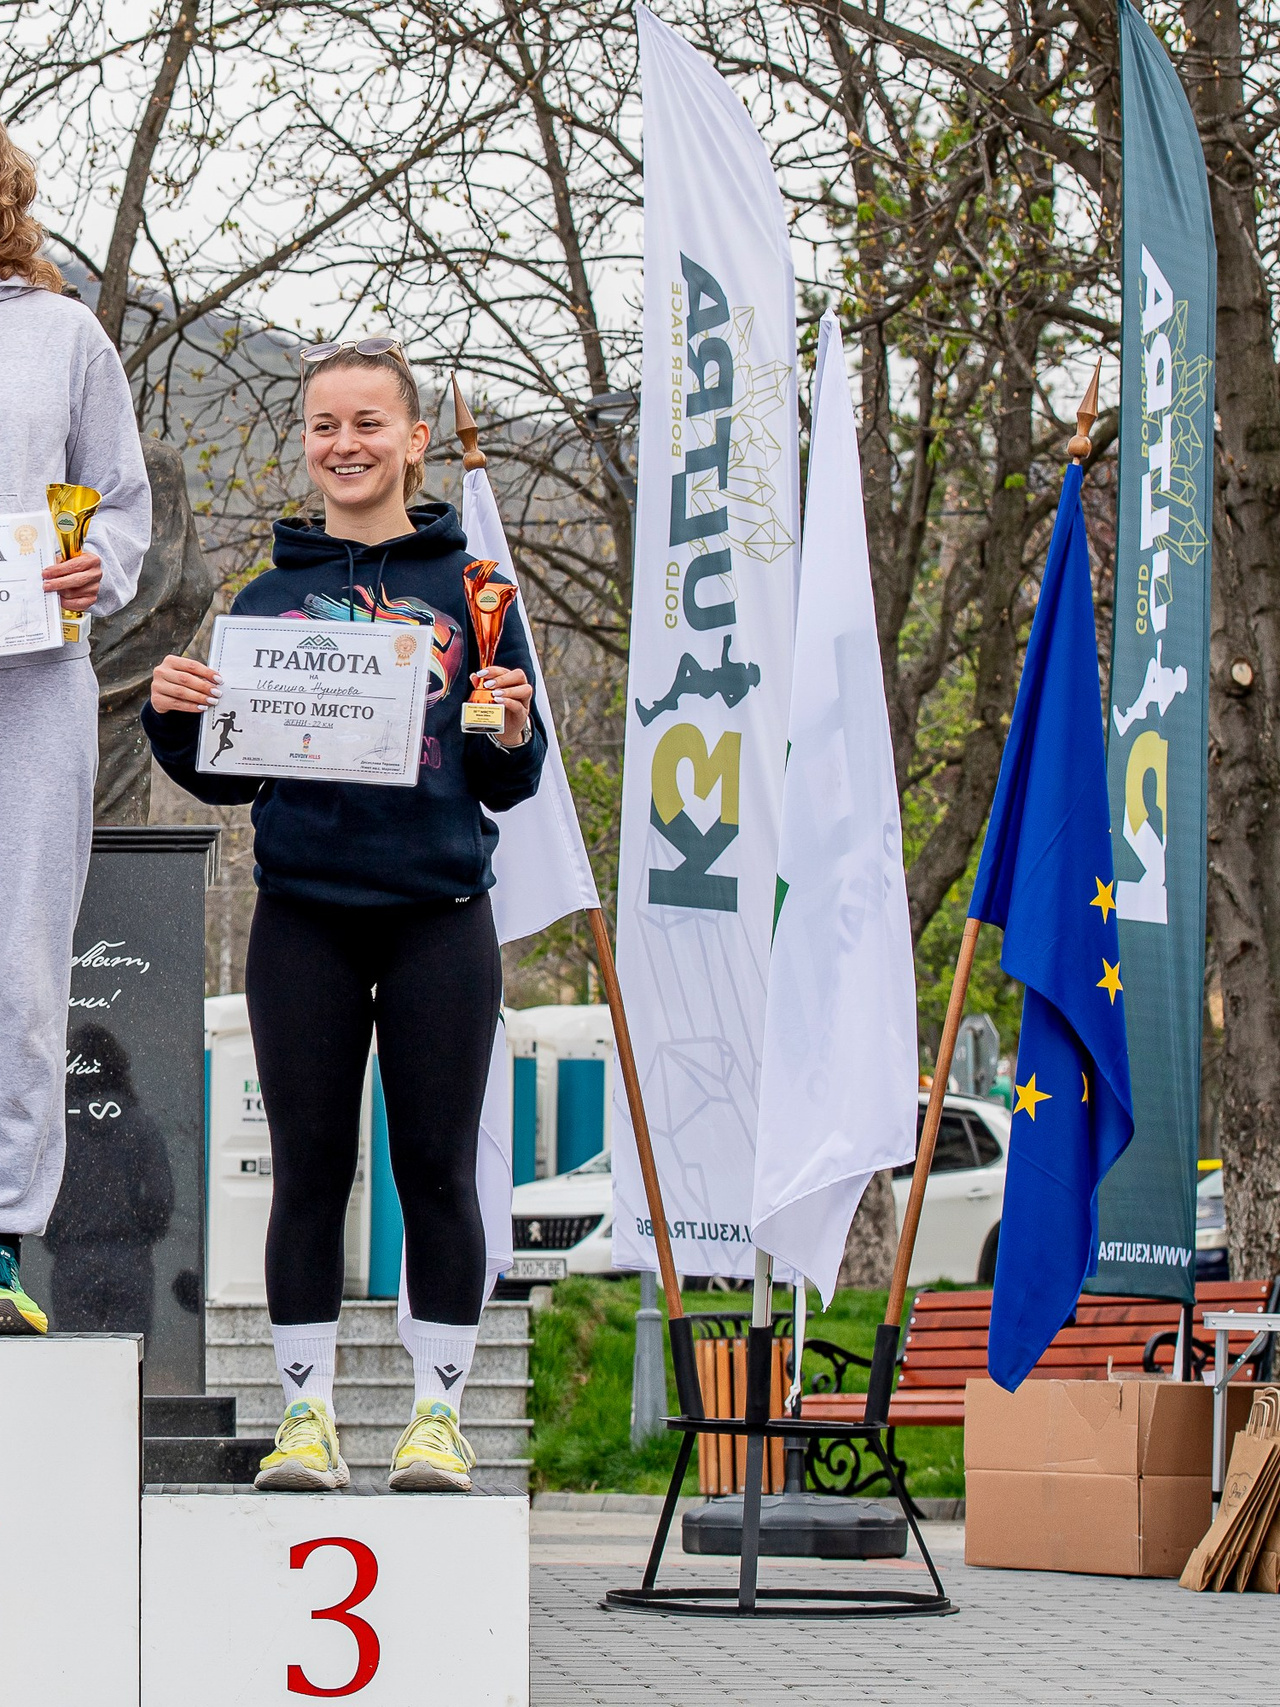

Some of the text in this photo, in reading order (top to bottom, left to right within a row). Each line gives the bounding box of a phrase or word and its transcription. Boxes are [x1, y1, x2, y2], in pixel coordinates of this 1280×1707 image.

[253, 649, 382, 675] ГРАМОТА
[250, 699, 374, 720] ТРЕТО МЯСТО
[283, 719, 308, 728] ЖЕНИ
[313, 720, 321, 728] 22
[287, 1536, 381, 1698] 3
